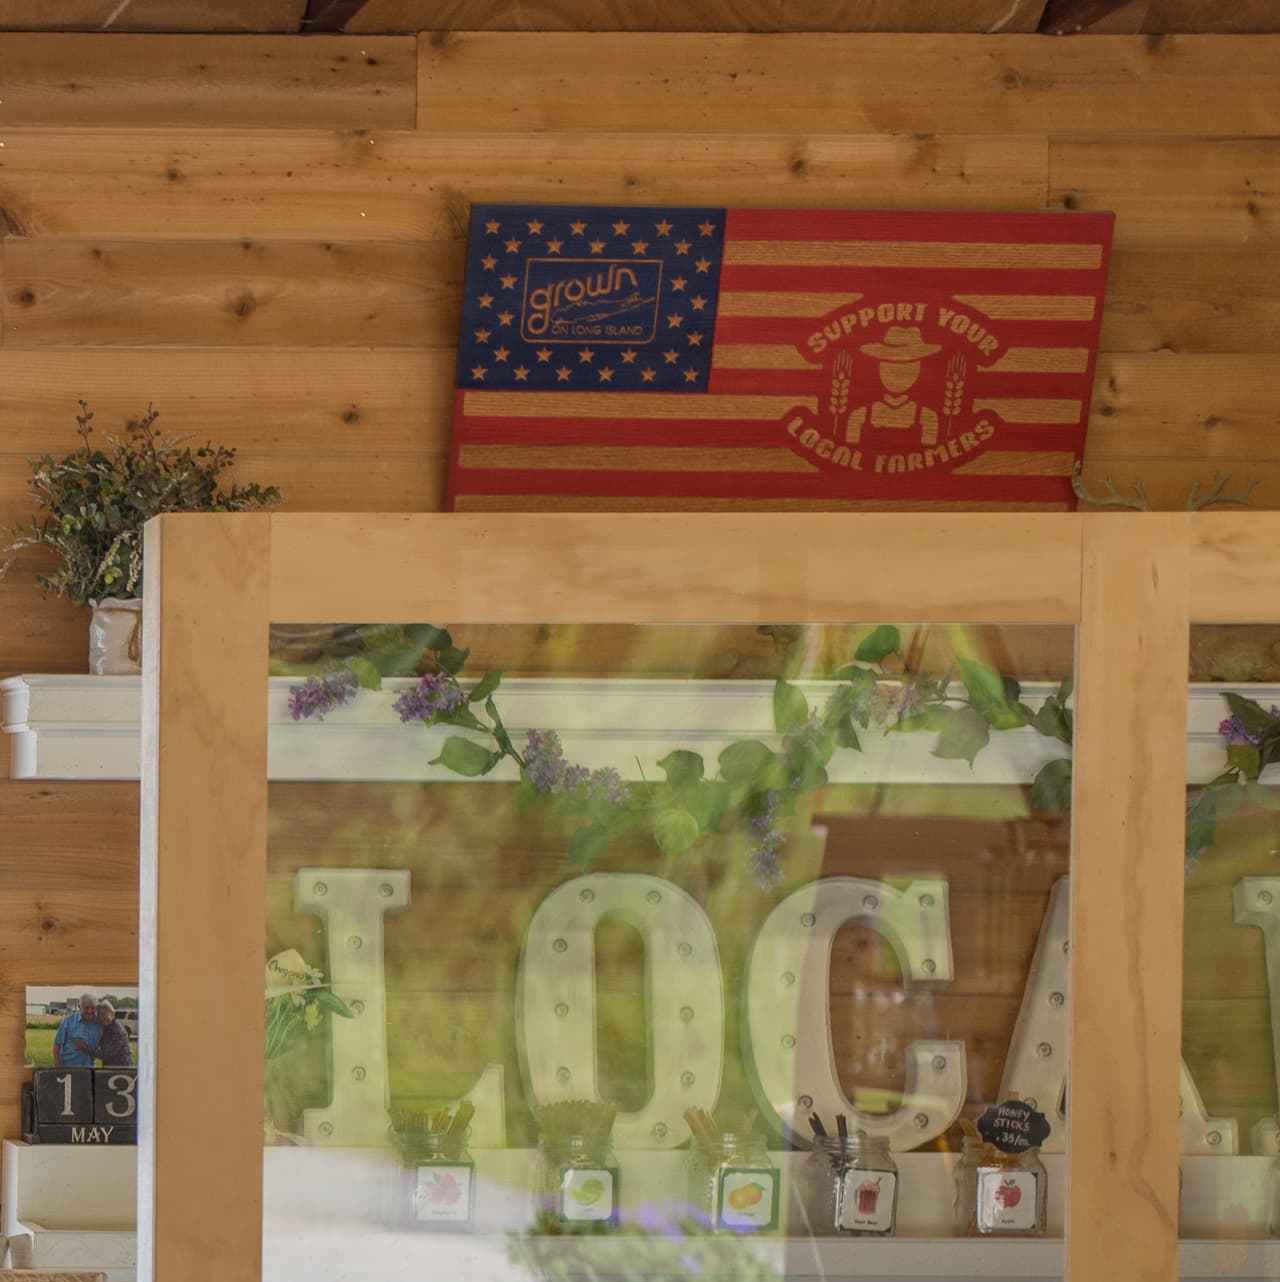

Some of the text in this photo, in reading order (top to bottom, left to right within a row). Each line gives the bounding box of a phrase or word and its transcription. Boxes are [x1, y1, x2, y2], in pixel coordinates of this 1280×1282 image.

[527, 263, 639, 335] grown
[551, 325, 644, 336] ON LONG ISLAND
[807, 303, 999, 357] SUPPORT YOUR
[786, 416, 996, 474] LOCAL FARMERS
[56, 1073, 137, 1118] 13
[992, 1118, 1031, 1132] STICKS
[997, 1106, 1031, 1122] HONEY
[71, 1126, 114, 1143] MAY
